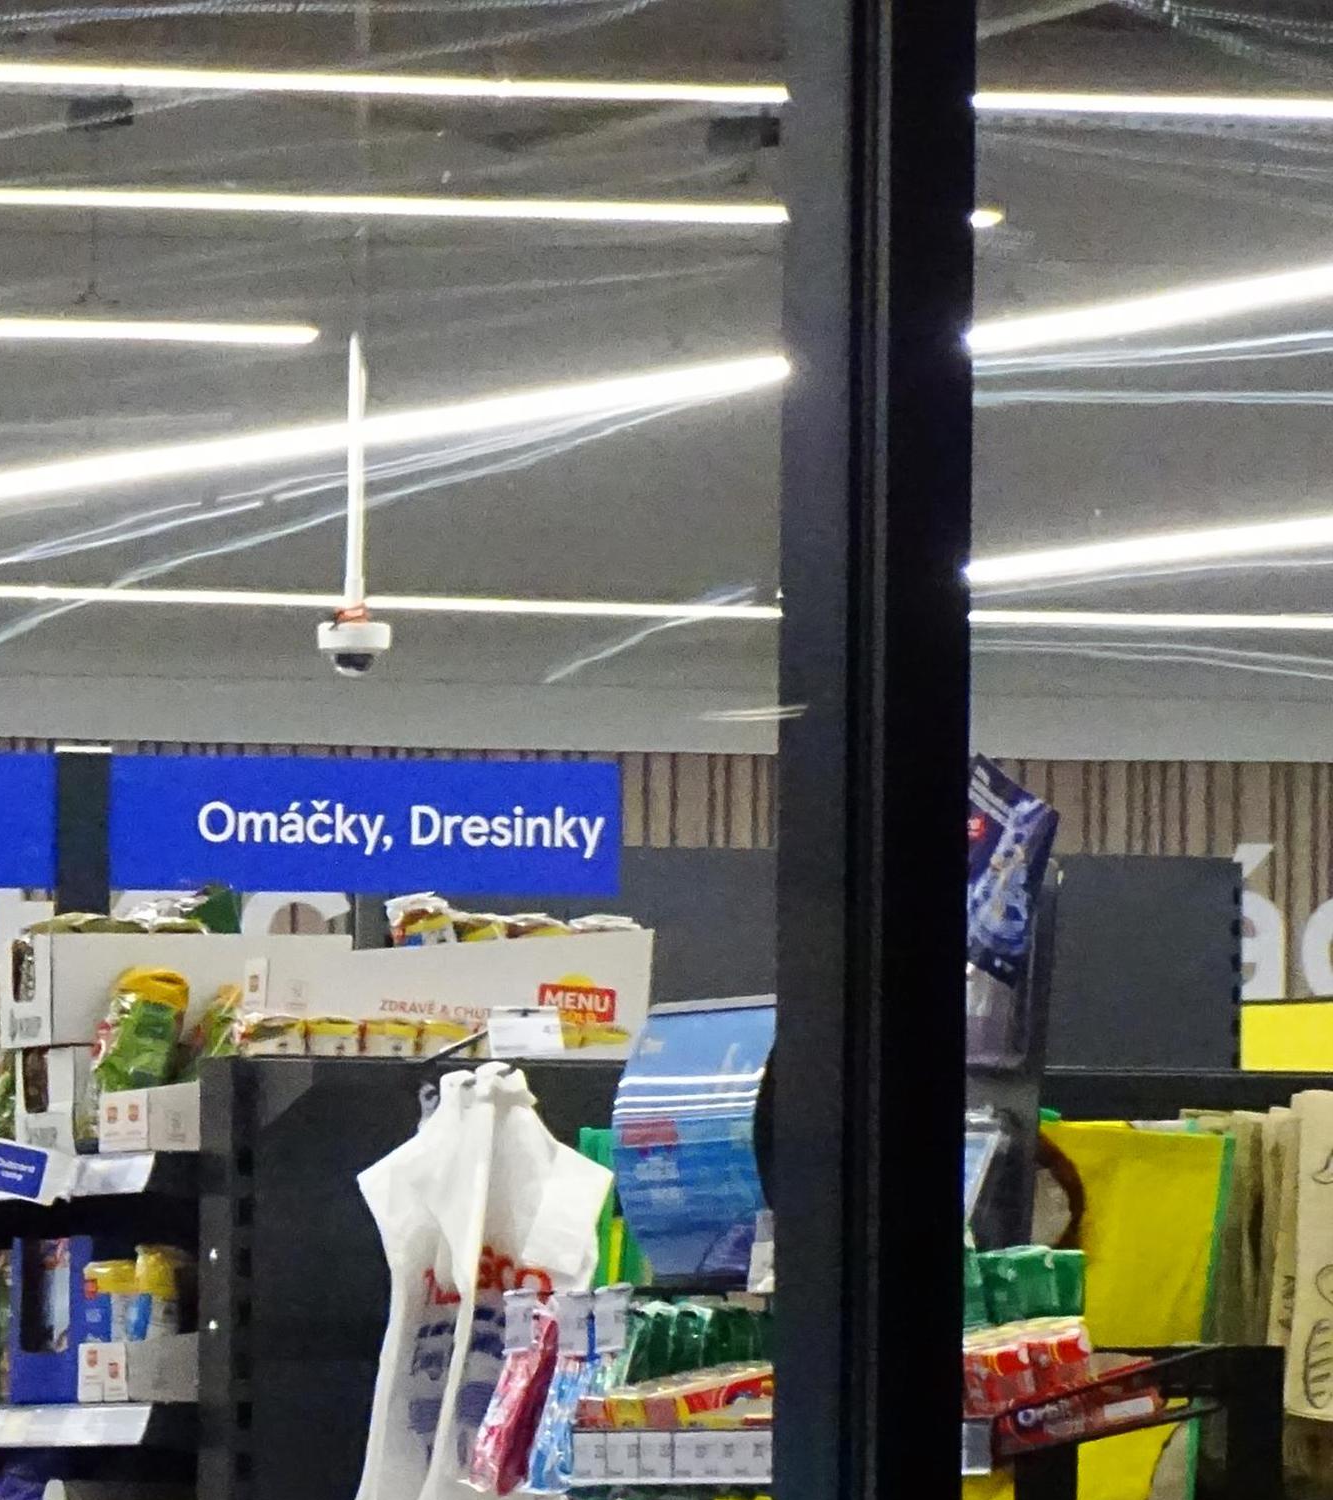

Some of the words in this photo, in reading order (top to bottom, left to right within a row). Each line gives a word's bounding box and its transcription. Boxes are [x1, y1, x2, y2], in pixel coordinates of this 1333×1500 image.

[197, 799, 393, 856] Omáčky,
[410, 804, 605, 859] Dresinky
[543, 989, 612, 1013] MENU
